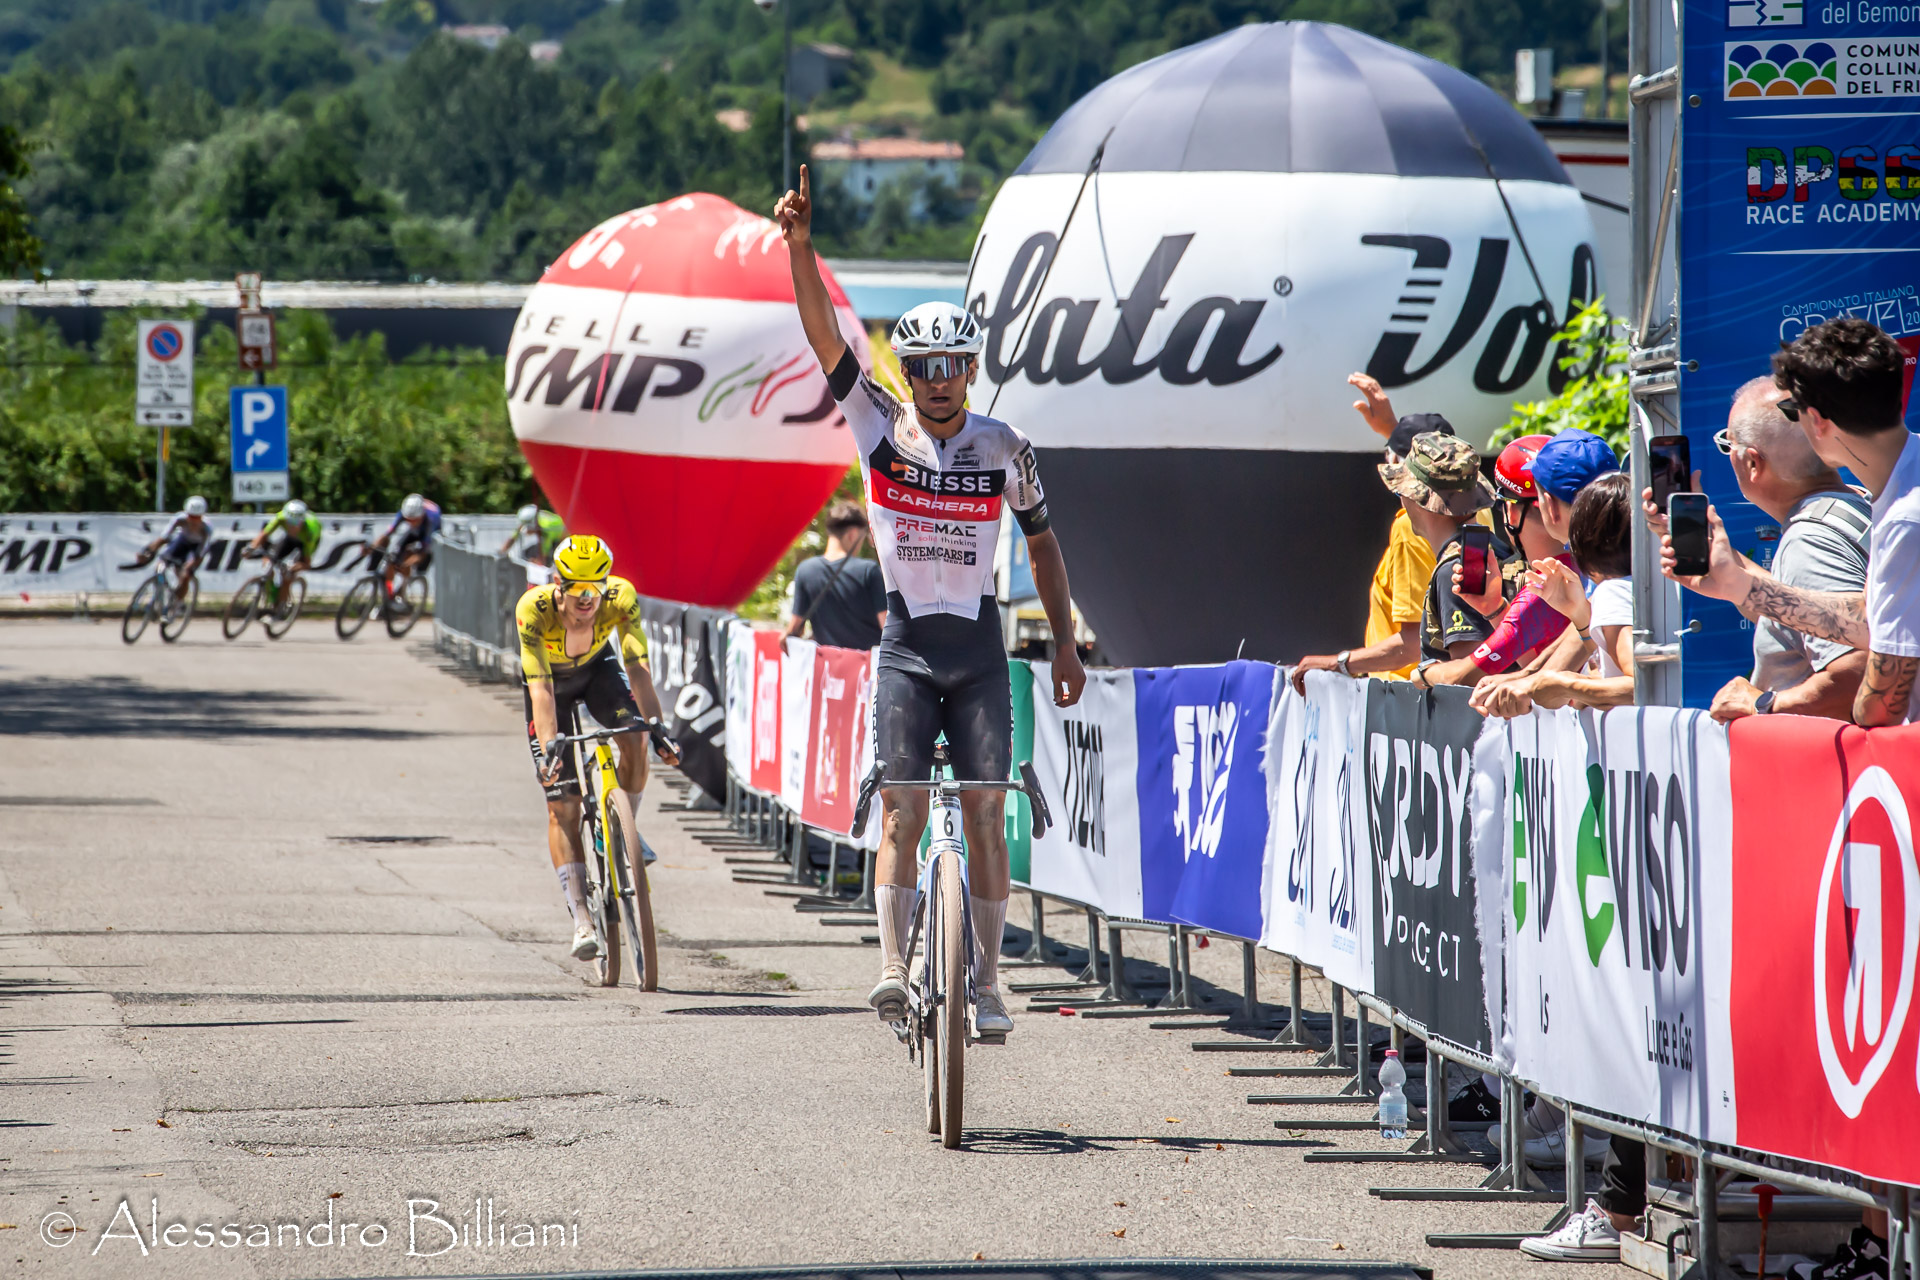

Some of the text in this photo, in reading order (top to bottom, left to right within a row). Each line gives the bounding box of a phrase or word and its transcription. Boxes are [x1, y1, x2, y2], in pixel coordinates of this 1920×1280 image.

[1822, 2, 1850, 24] del
[1847, 81, 1884, 95] DEL
[1746, 202, 1920, 225] RACE ACADEMY
[968, 230, 1284, 387] olata
[1782, 285, 1915, 317] CAMPIONATO ITALIANO
[522, 311, 708, 349] SELLE
[931, 317, 942, 341] 6
[508, 345, 705, 413] SMP
[242, 392, 275, 436] P
[903, 464, 992, 493] BIESSE
[886, 487, 988, 513] CARRERA
[0, 519, 90, 534] ELLE
[895, 516, 977, 538] PREMAC
[0, 537, 93, 574] MP
[940, 536, 977, 548] thinking
[943, 809, 954, 838] 6
[1645, 1005, 1670, 1065] Luce
[1679, 1012, 1693, 1073] Gas
